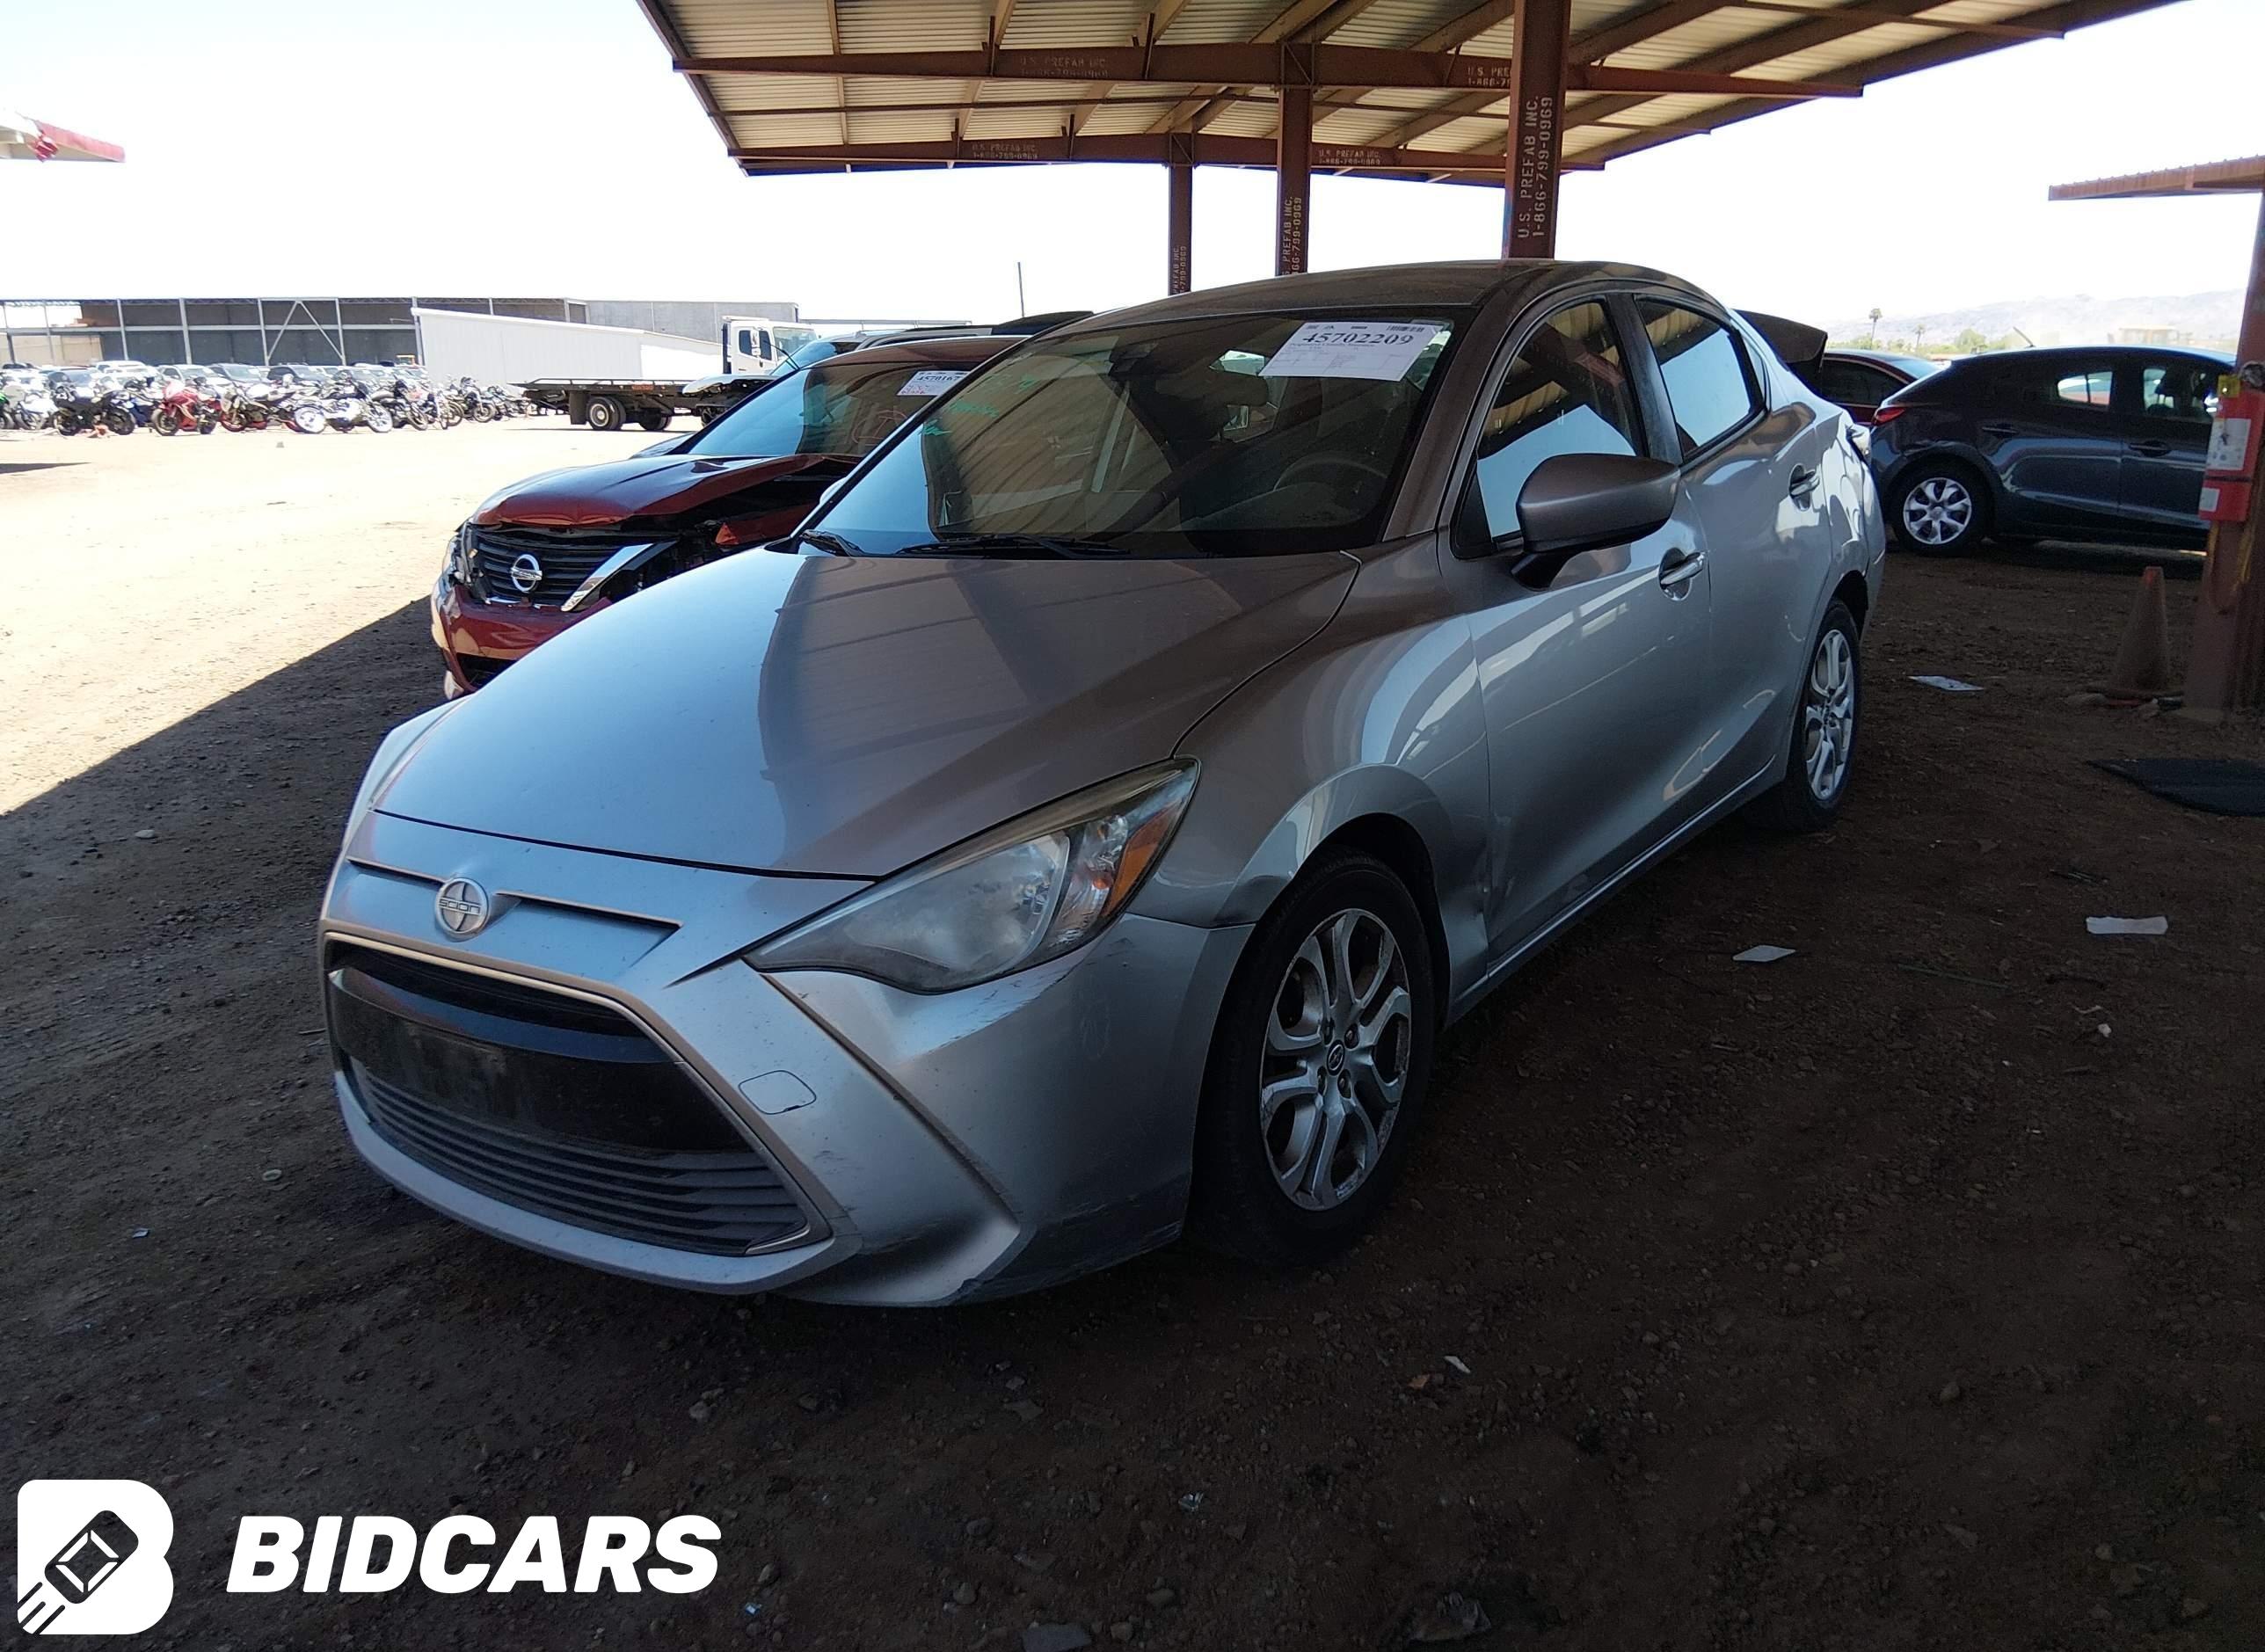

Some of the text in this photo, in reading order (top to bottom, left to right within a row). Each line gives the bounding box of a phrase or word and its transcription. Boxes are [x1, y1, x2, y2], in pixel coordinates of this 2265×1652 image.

[1517, 95, 1539, 238] U.S. PREFAB INC.
[1533, 97, 1553, 237] 1-866-799-0969
[1284, 196, 1293, 216] INC.
[1282, 222, 1293, 262] PREFAB
[1302, 332, 1415, 345] 45702209
